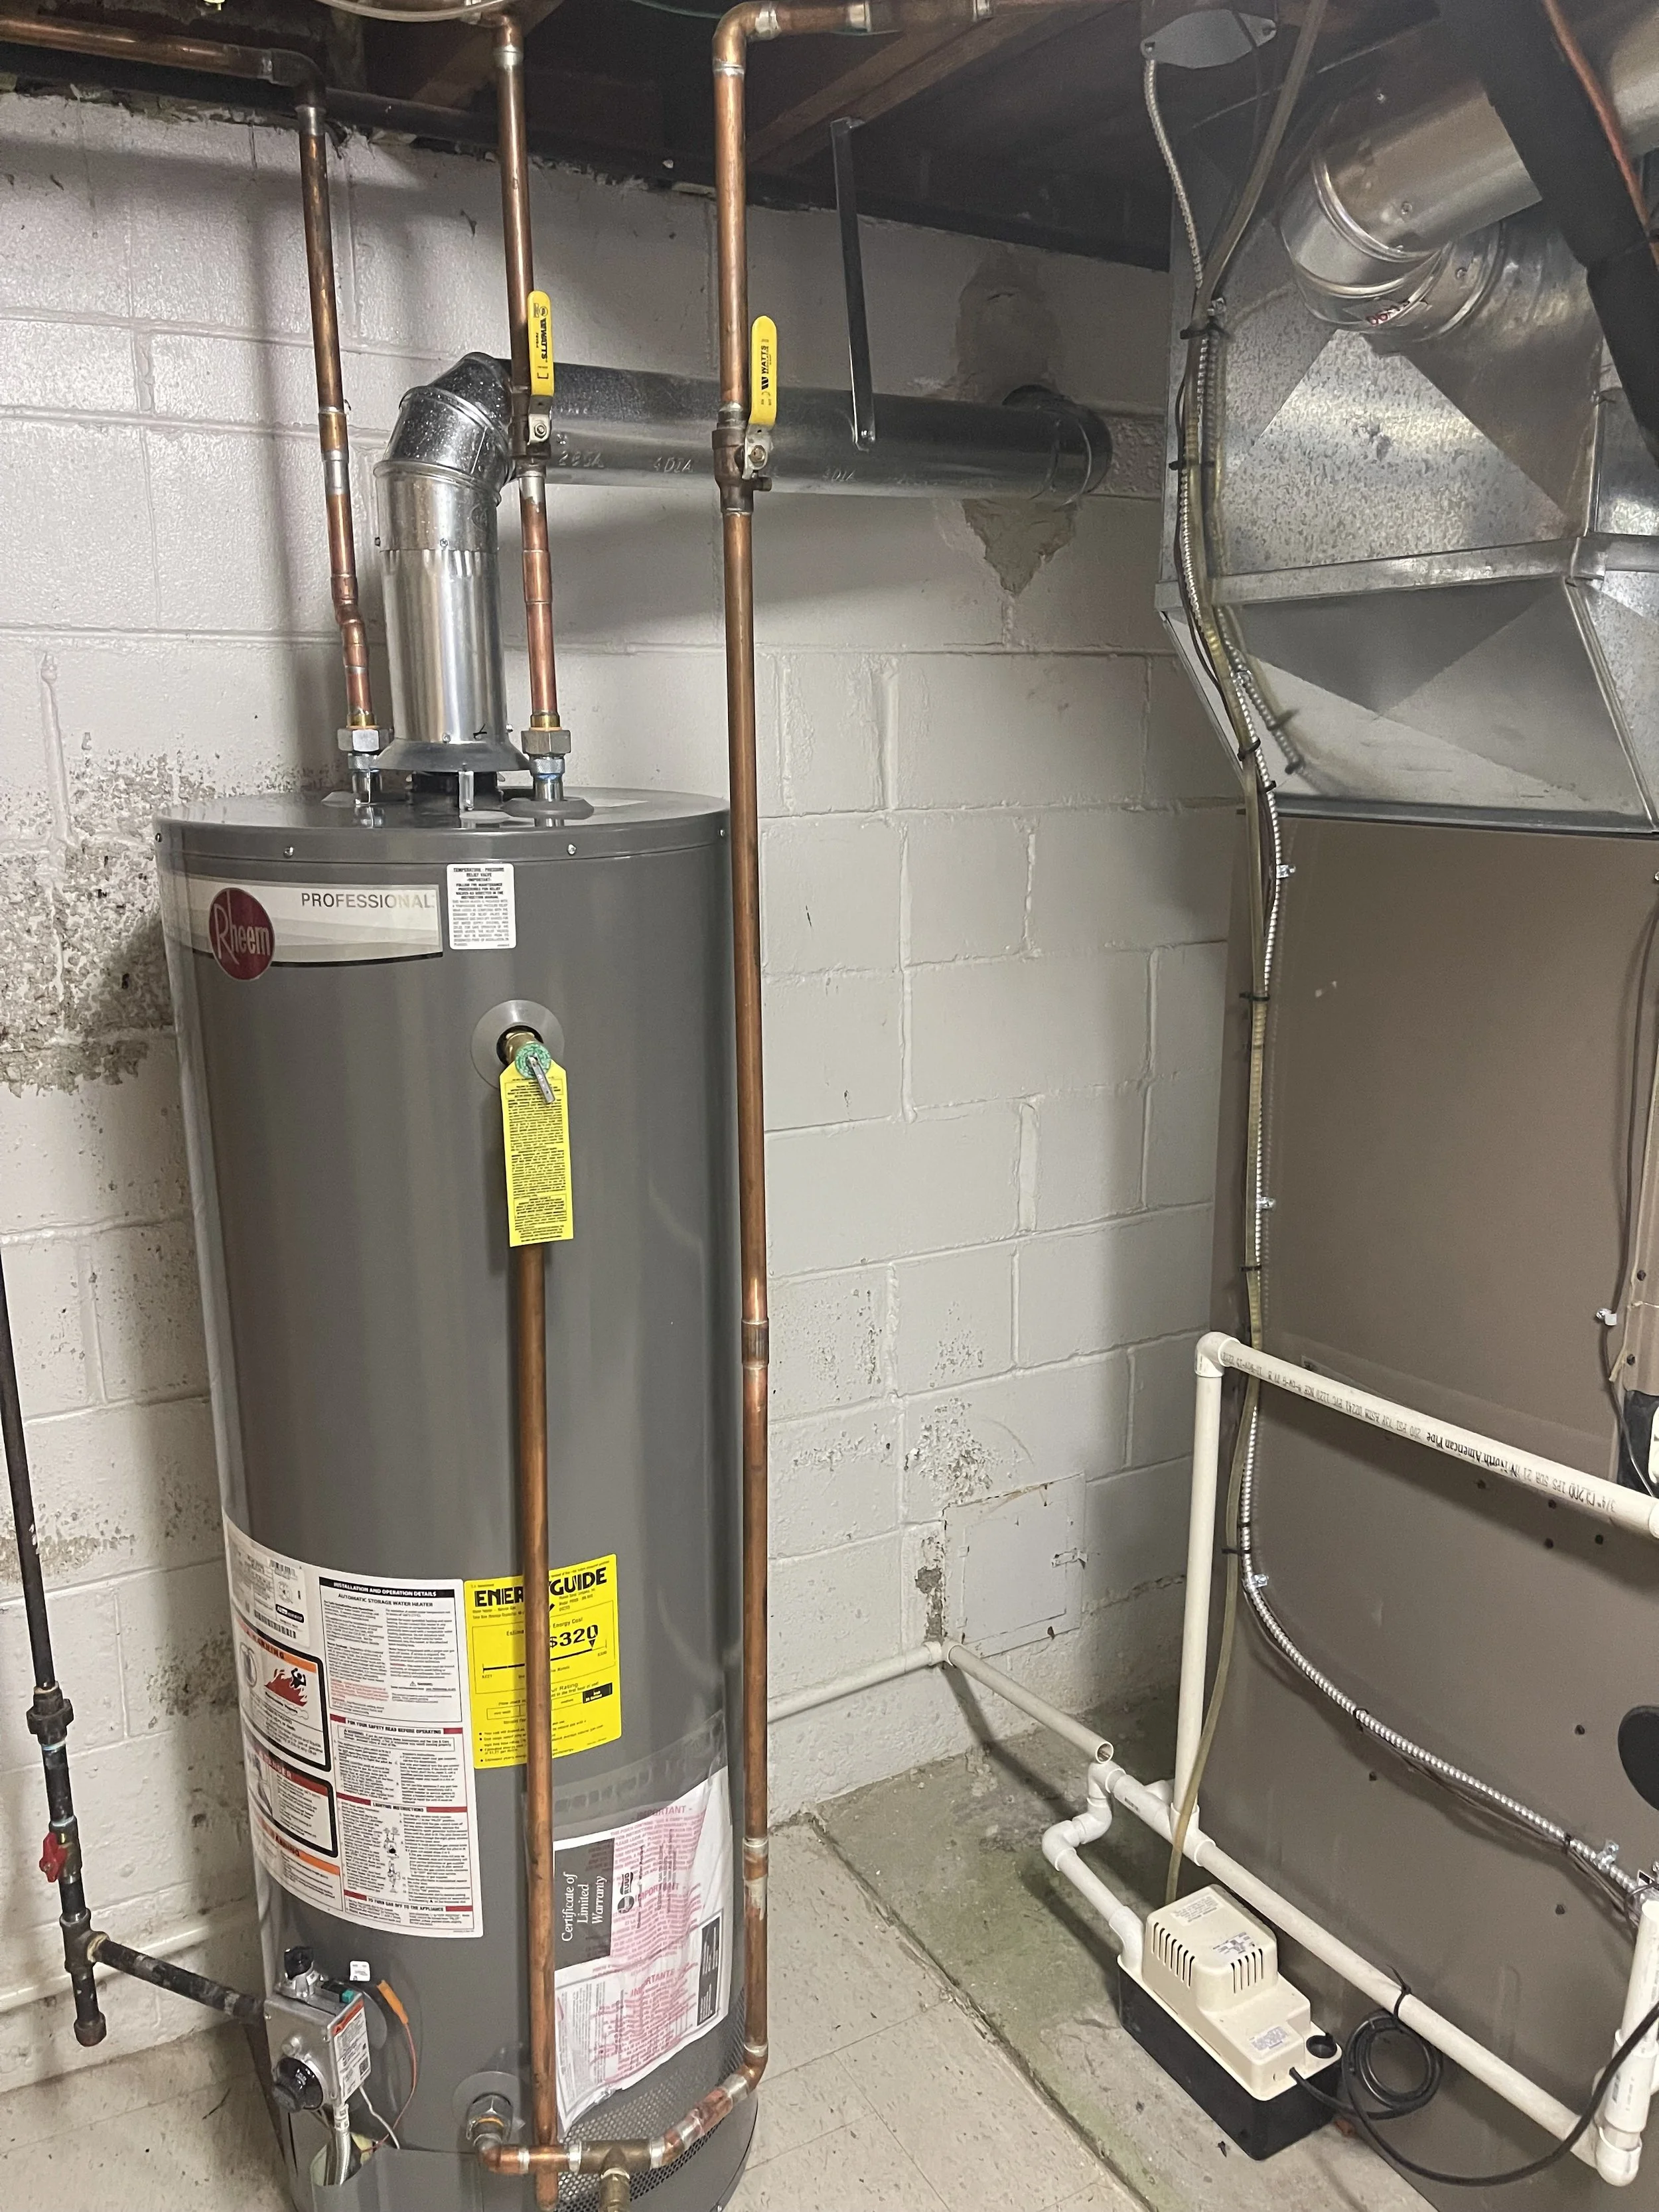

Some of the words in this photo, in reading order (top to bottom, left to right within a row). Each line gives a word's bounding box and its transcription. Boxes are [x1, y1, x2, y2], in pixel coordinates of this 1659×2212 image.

[212, 890, 271, 964] Rheem
[1444, 1439, 1483, 1463] American
[333, 1582, 368, 1593] INSTALLATION
[338, 1593, 367, 1603] AUTOMATIC
[549, 1624, 599, 1649] $320
[563, 1871, 578, 1884] of
[577, 1883, 589, 1923] Limited
[591, 1876, 607, 1924] Warranty
[561, 1886, 577, 1942] Certificate
